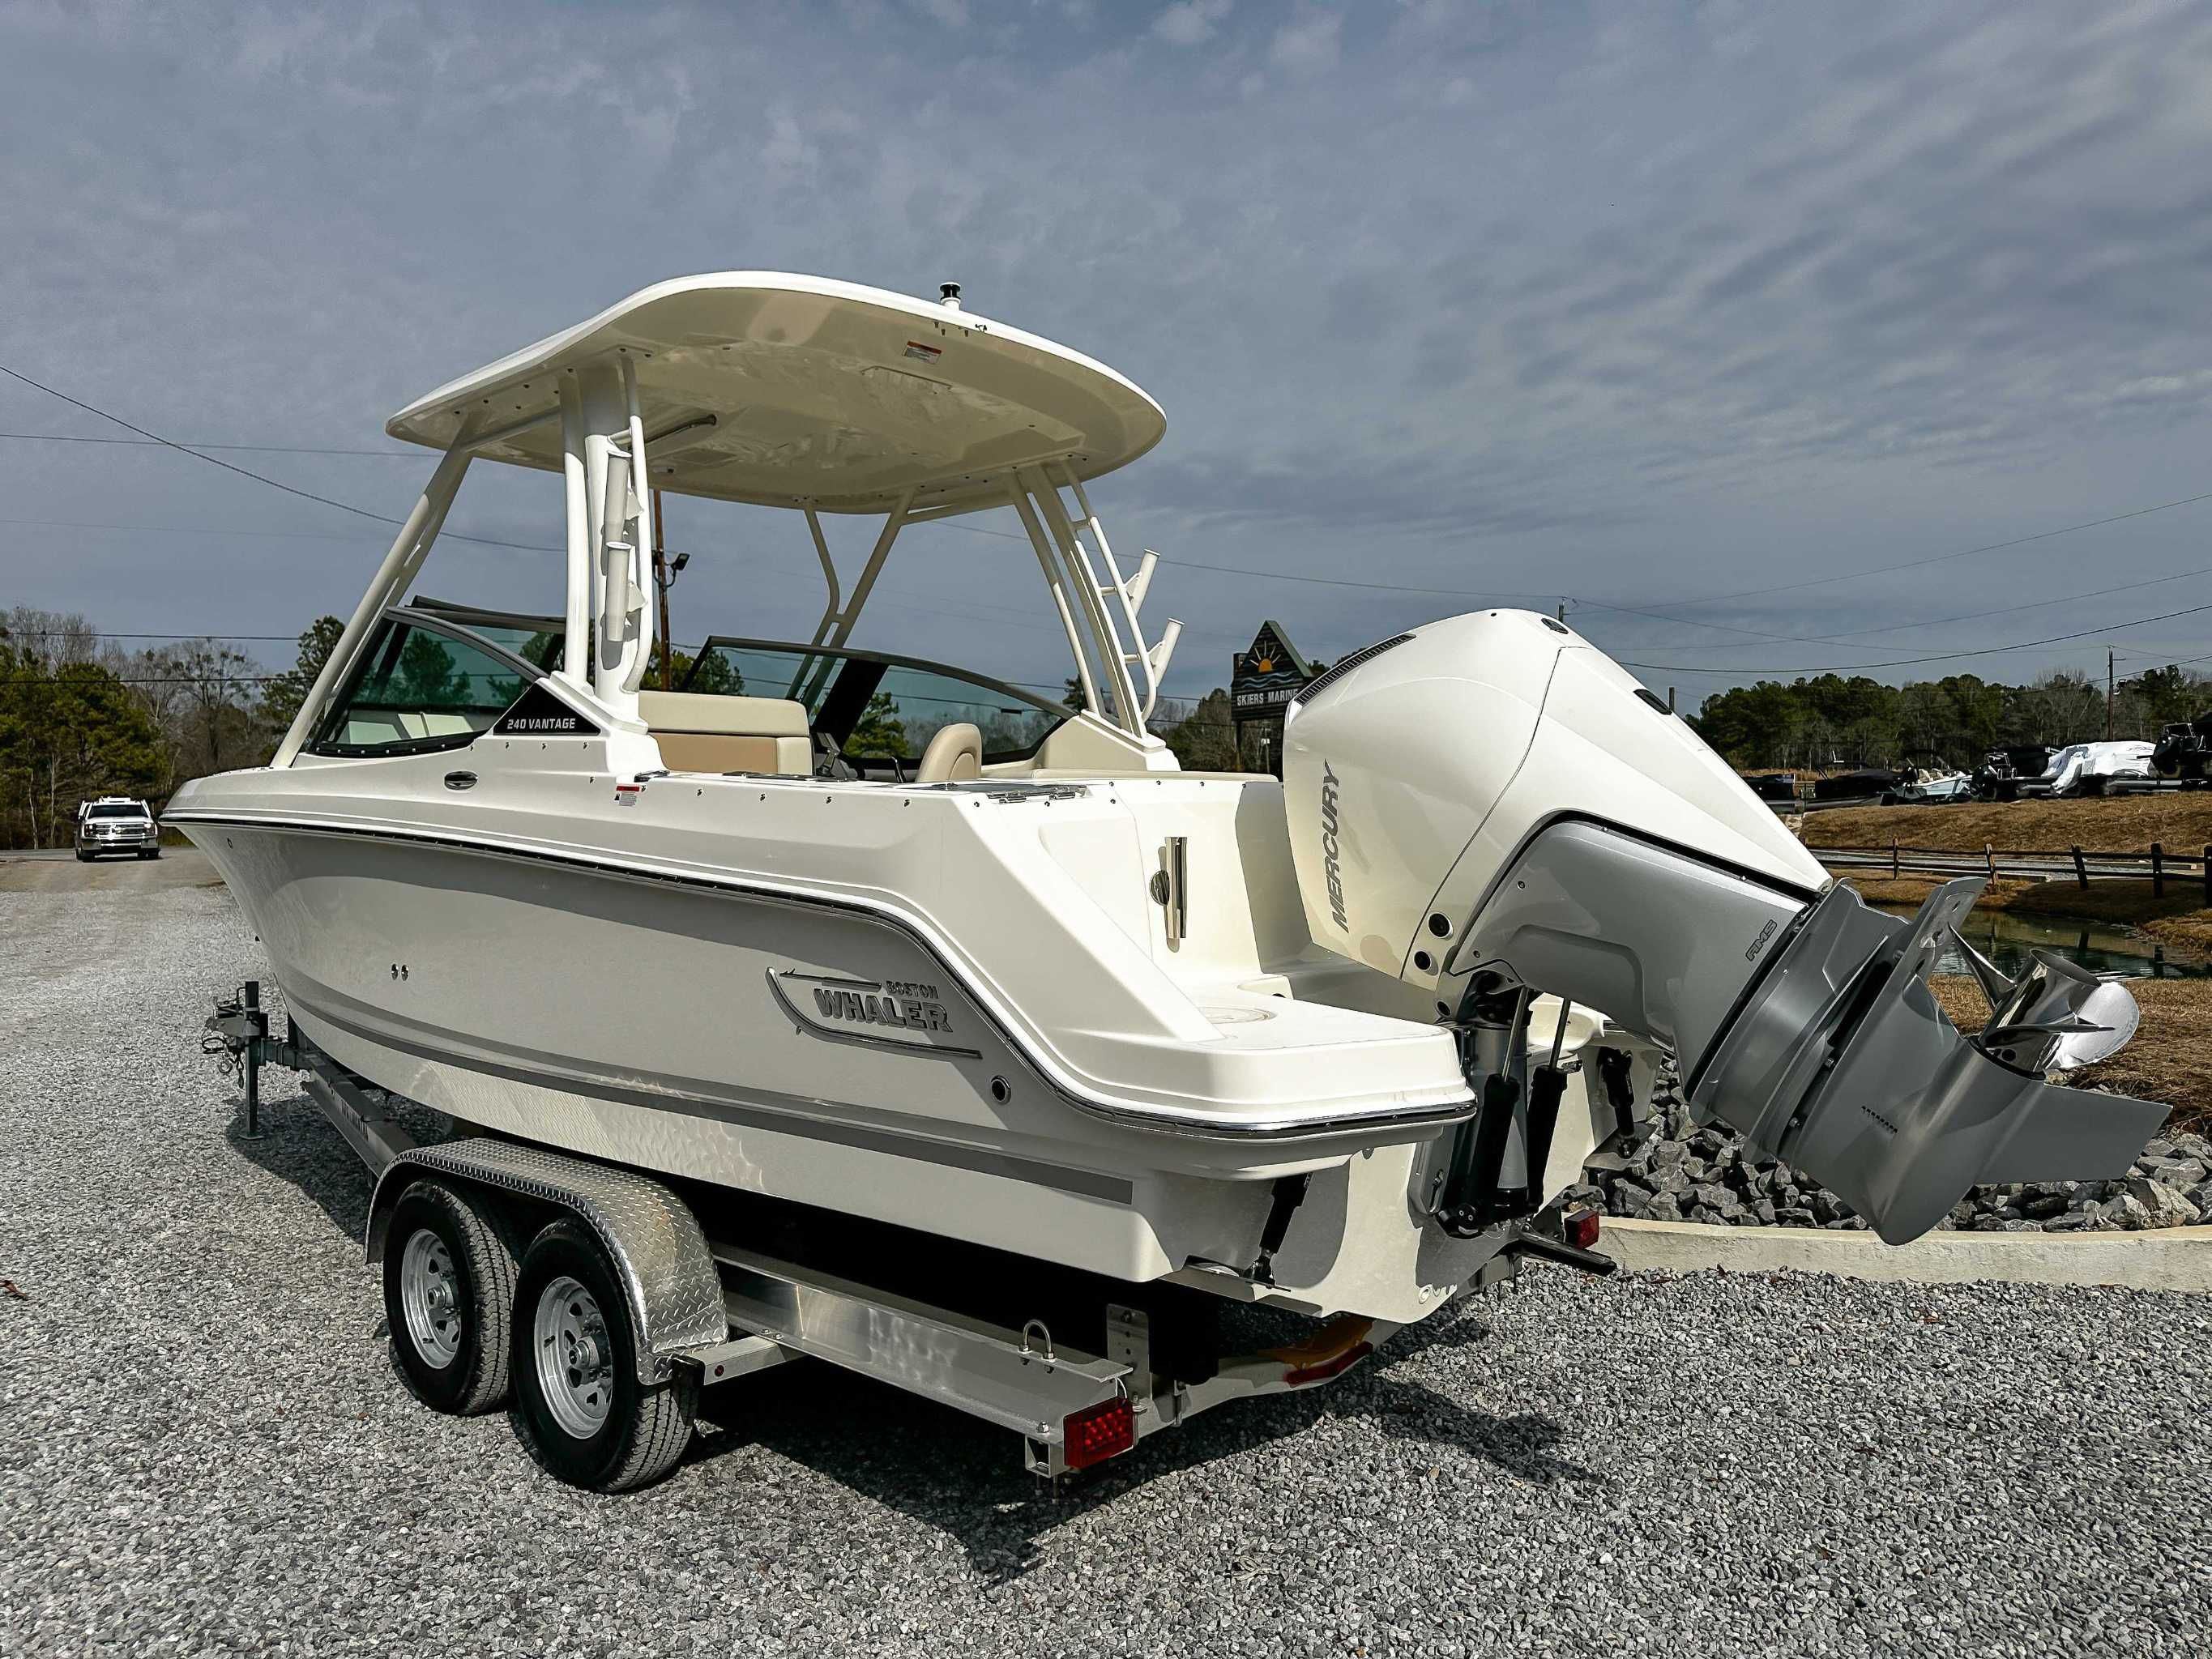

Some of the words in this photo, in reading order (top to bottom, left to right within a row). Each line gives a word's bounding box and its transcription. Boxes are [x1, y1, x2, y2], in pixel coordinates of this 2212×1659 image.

[1236, 693, 1264, 706] SKIERS
[506, 719, 527, 729] 240
[528, 718, 576, 729] VANTAGE
[1322, 758, 1349, 934] MERCURY
[1745, 919, 1778, 962] AMS
[886, 980, 940, 999] BOSTON
[813, 987, 954, 1033] WHALER
